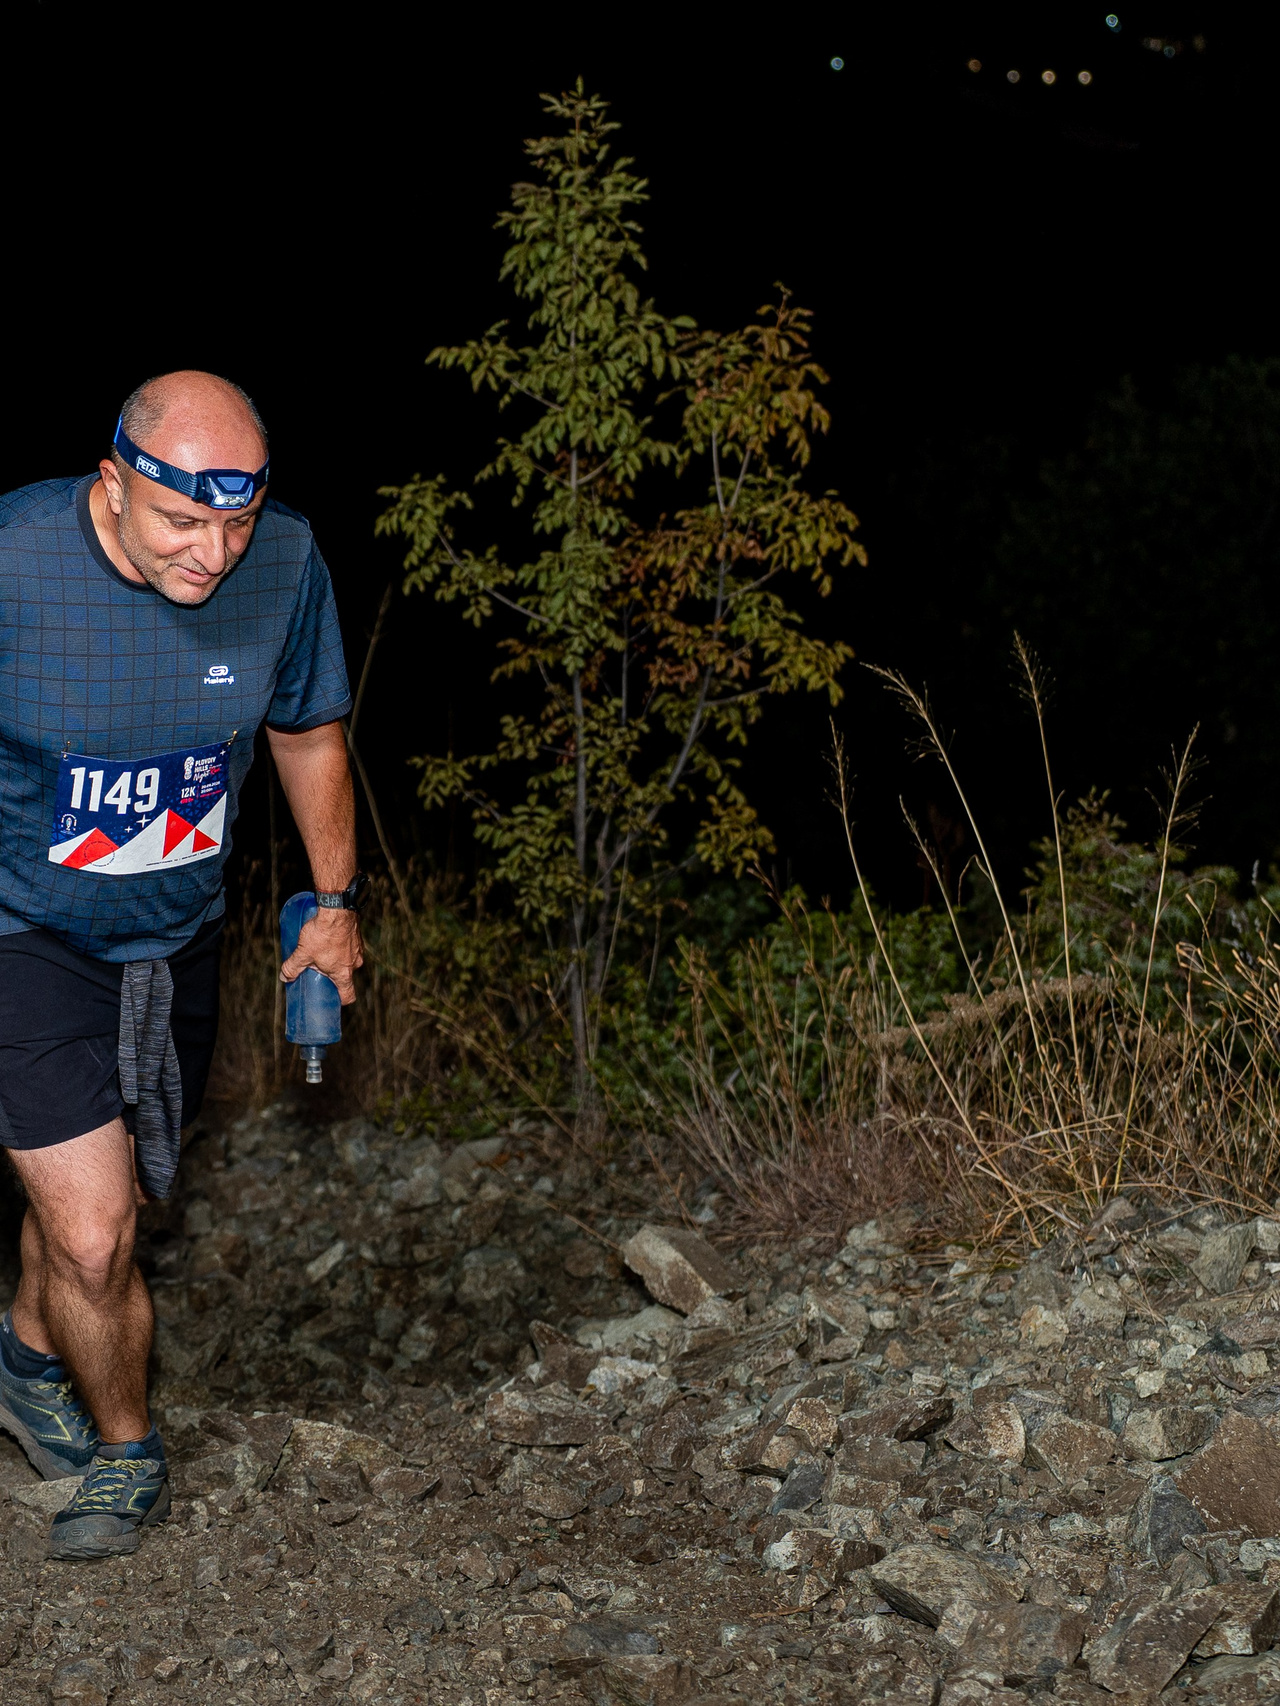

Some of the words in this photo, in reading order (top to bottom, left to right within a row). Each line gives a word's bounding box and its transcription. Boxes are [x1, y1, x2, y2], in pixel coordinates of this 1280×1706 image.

[136, 457, 160, 478] PETZL
[70, 766, 161, 815] 1149
[181, 786, 197, 799] 12K
